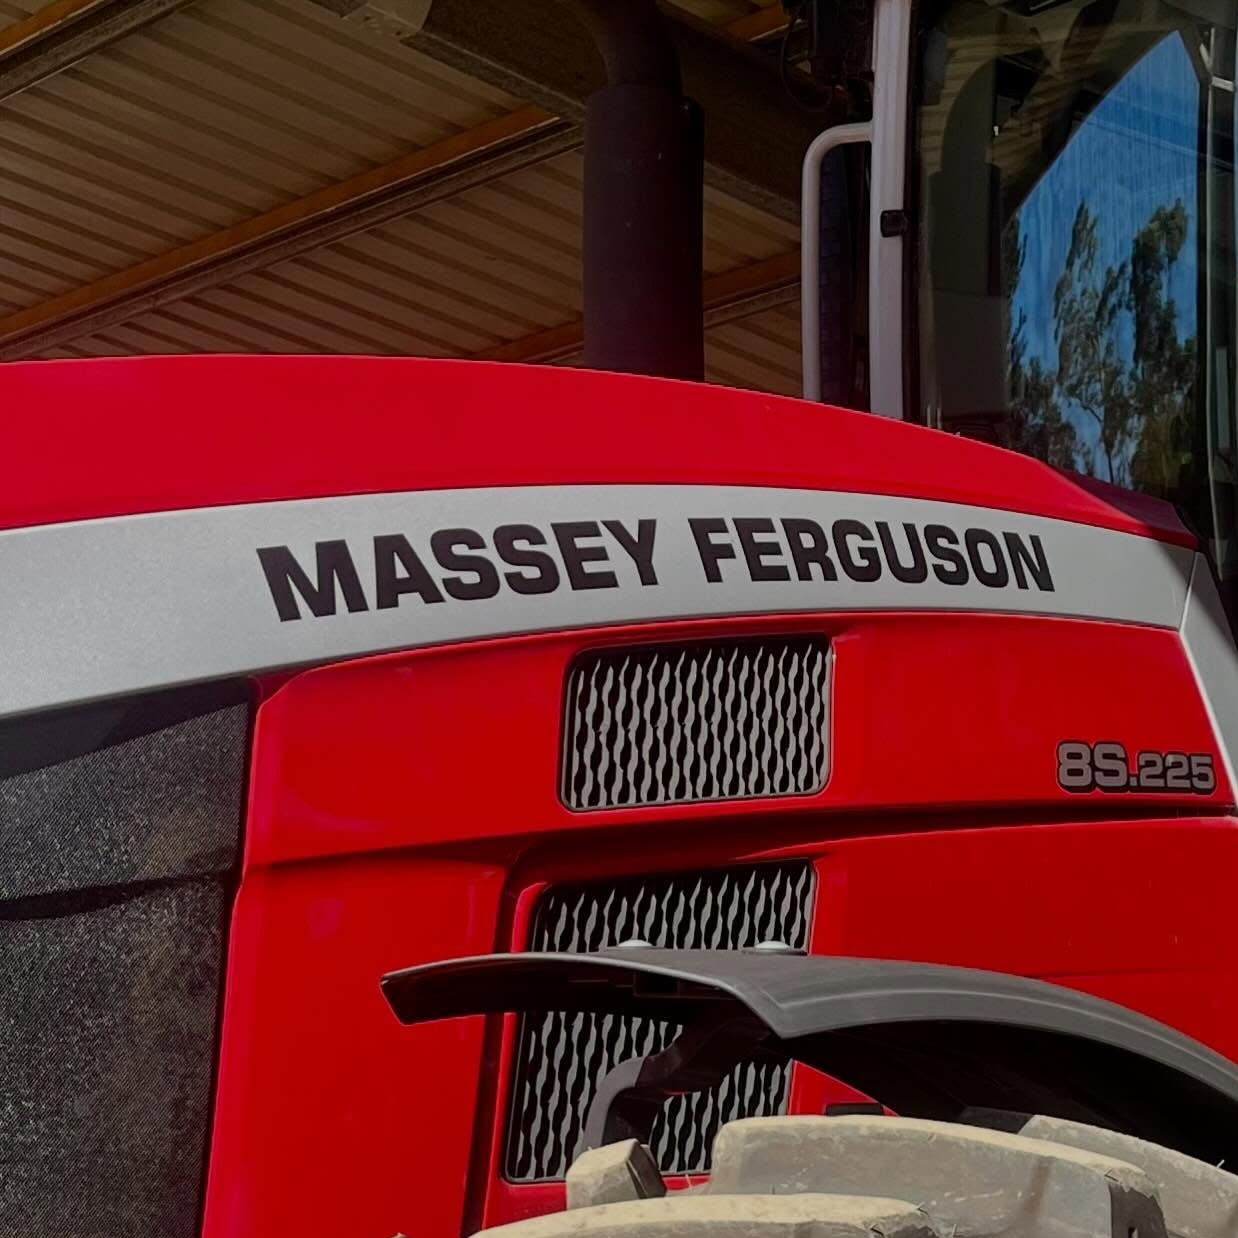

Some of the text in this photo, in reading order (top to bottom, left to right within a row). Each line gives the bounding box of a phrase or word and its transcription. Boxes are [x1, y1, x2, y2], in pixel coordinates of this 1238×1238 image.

[256, 518, 1056, 623] MASSEY FERGUSON
[1056, 741, 1216, 793] 8S.225
